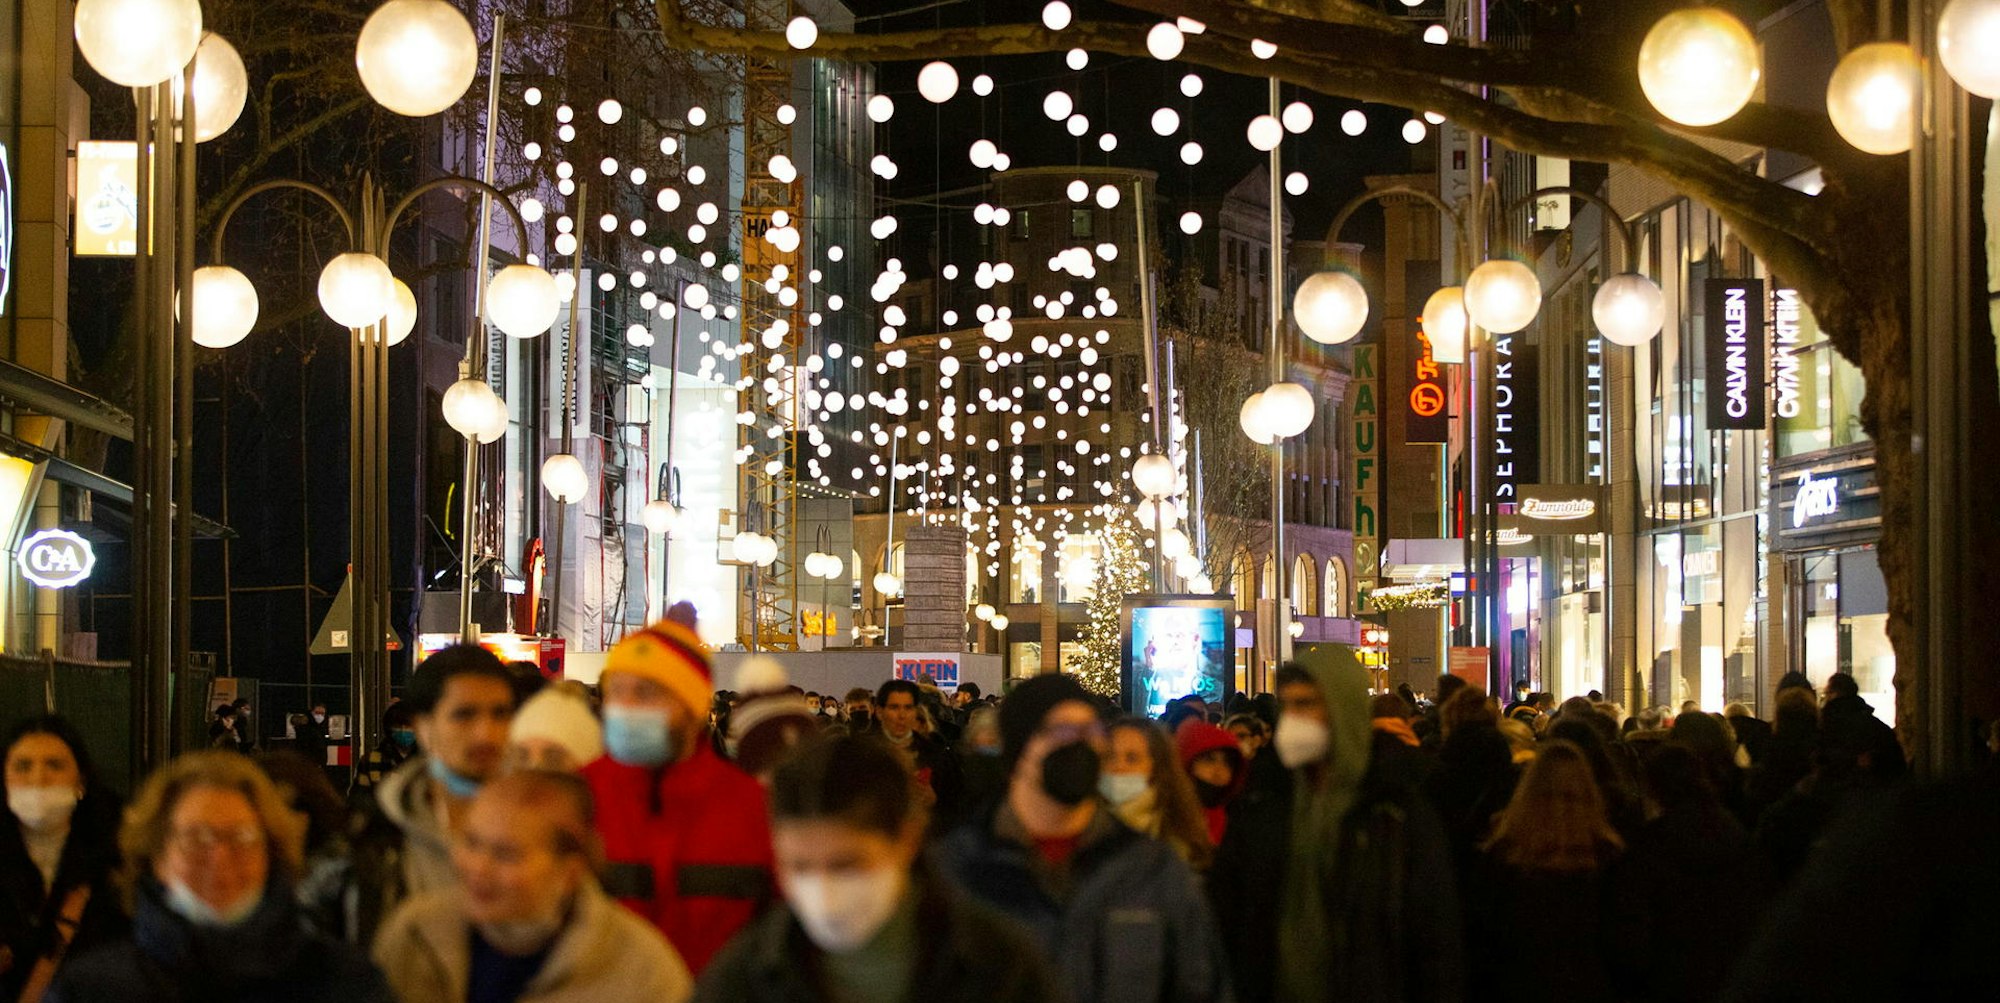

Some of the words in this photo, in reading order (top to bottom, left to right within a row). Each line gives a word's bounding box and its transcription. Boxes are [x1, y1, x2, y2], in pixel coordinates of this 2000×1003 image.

[1725, 288, 1746, 343] KLEIN
[1726, 346, 1747, 418] CALVIN
[1496, 337, 1513, 497] SEPHORA
[31, 544, 82, 572] C&A
